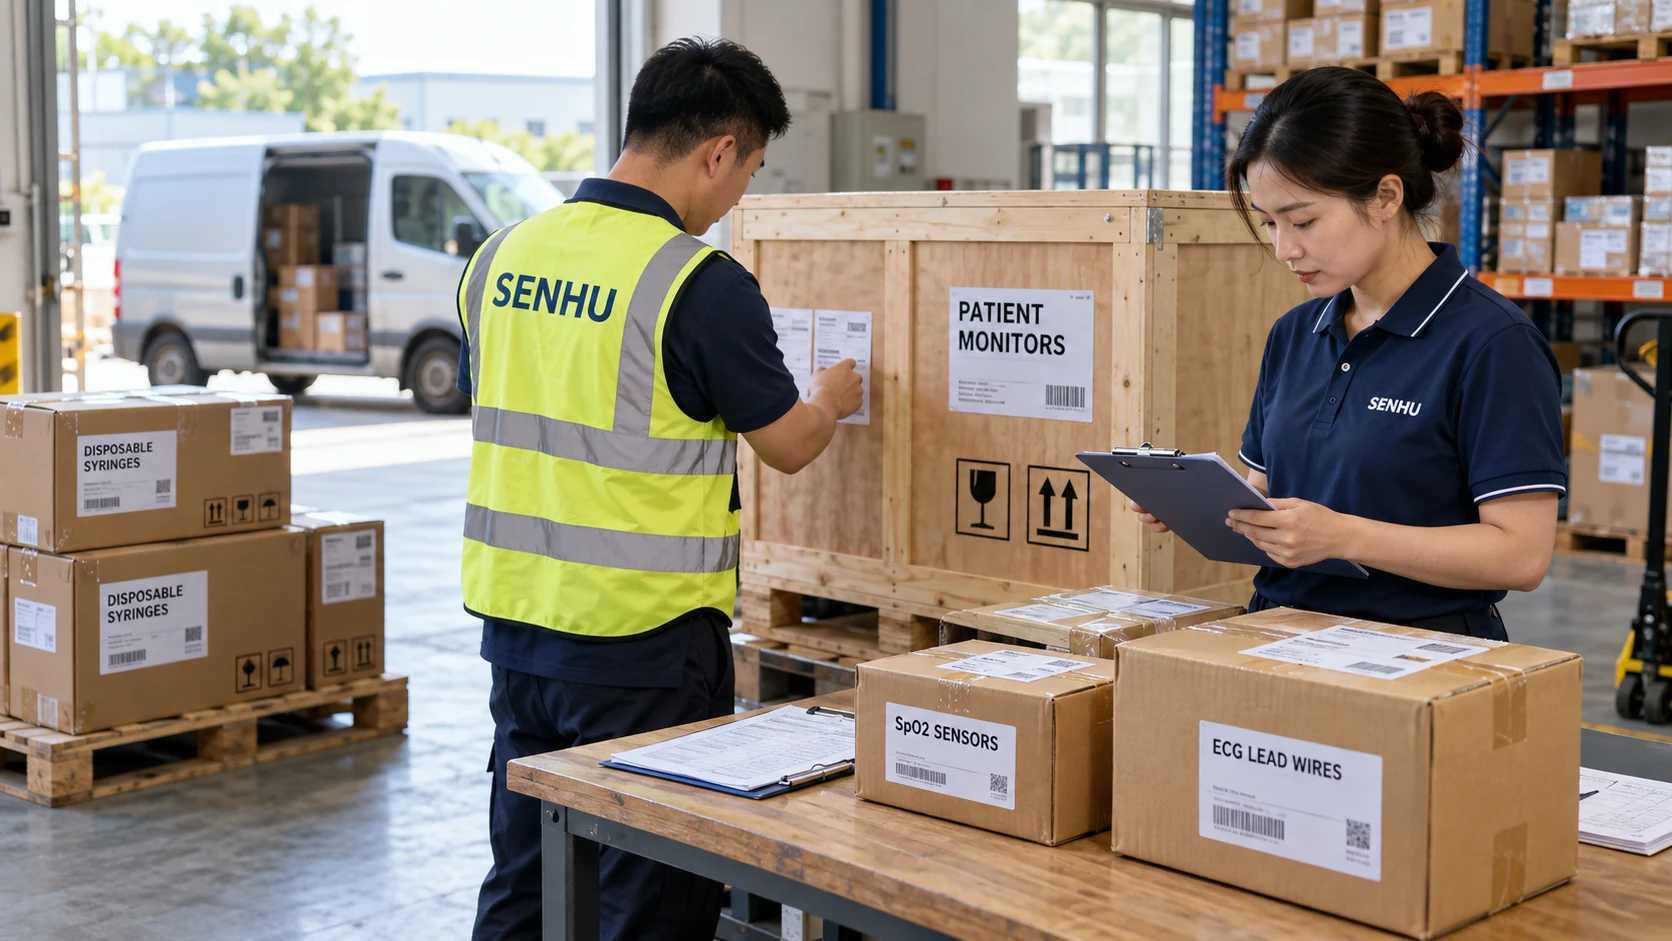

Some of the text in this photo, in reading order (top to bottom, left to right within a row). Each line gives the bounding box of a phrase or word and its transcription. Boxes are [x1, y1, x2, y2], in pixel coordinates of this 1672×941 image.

[492, 272, 618, 323] SENHU
[958, 300, 1044, 325] PATIENT
[958, 329, 1066, 356] MONITORS
[1367, 396, 1422, 417] SENHU
[84, 441, 153, 458] DISPOSABLE
[84, 457, 141, 473] SYRINGES
[107, 584, 184, 608] DISPOSABLE
[107, 603, 169, 624] SYRINGES
[933, 724, 999, 752] SENSORS
[1212, 738, 1342, 782] ECG LEAD WIRES
